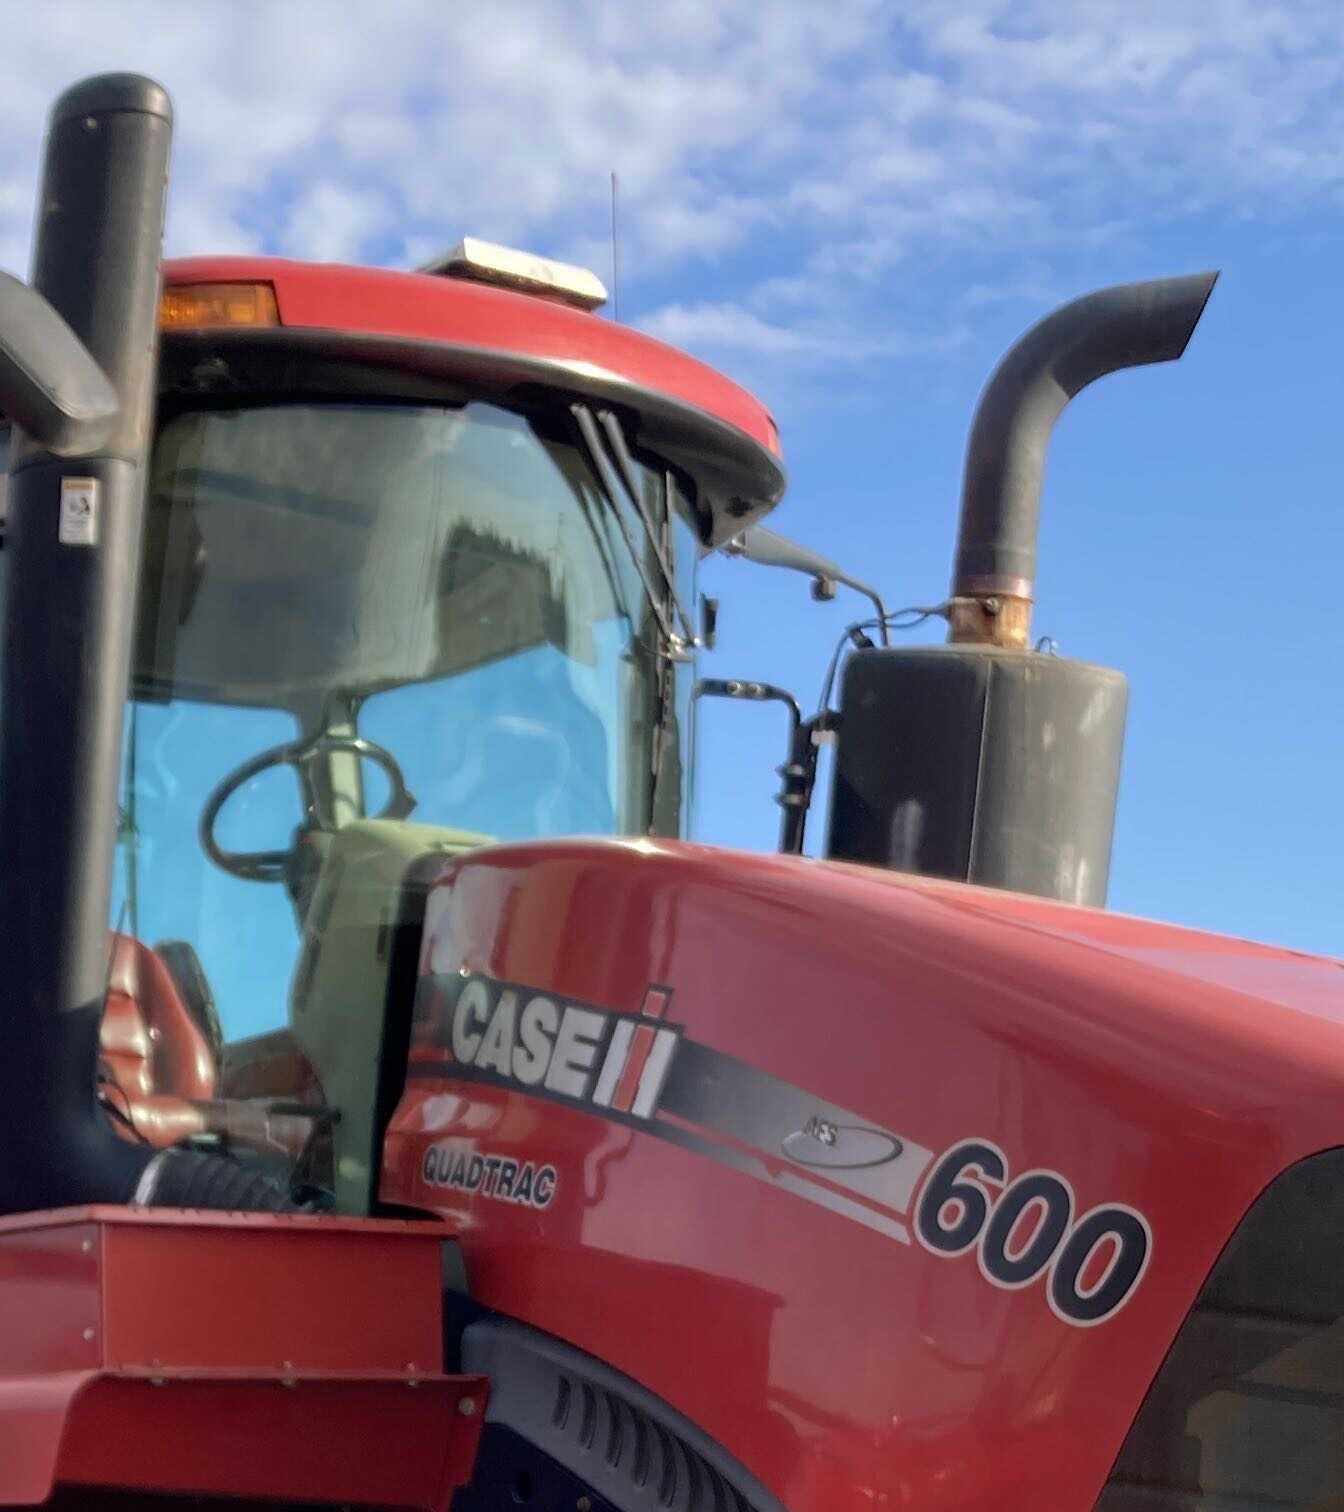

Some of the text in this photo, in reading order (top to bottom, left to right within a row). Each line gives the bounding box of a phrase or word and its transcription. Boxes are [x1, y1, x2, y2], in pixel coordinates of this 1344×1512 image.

[452, 980, 605, 1098] CASE
[423, 1146, 556, 1209] QUADTRAC
[913, 1137, 1153, 1328] 600
